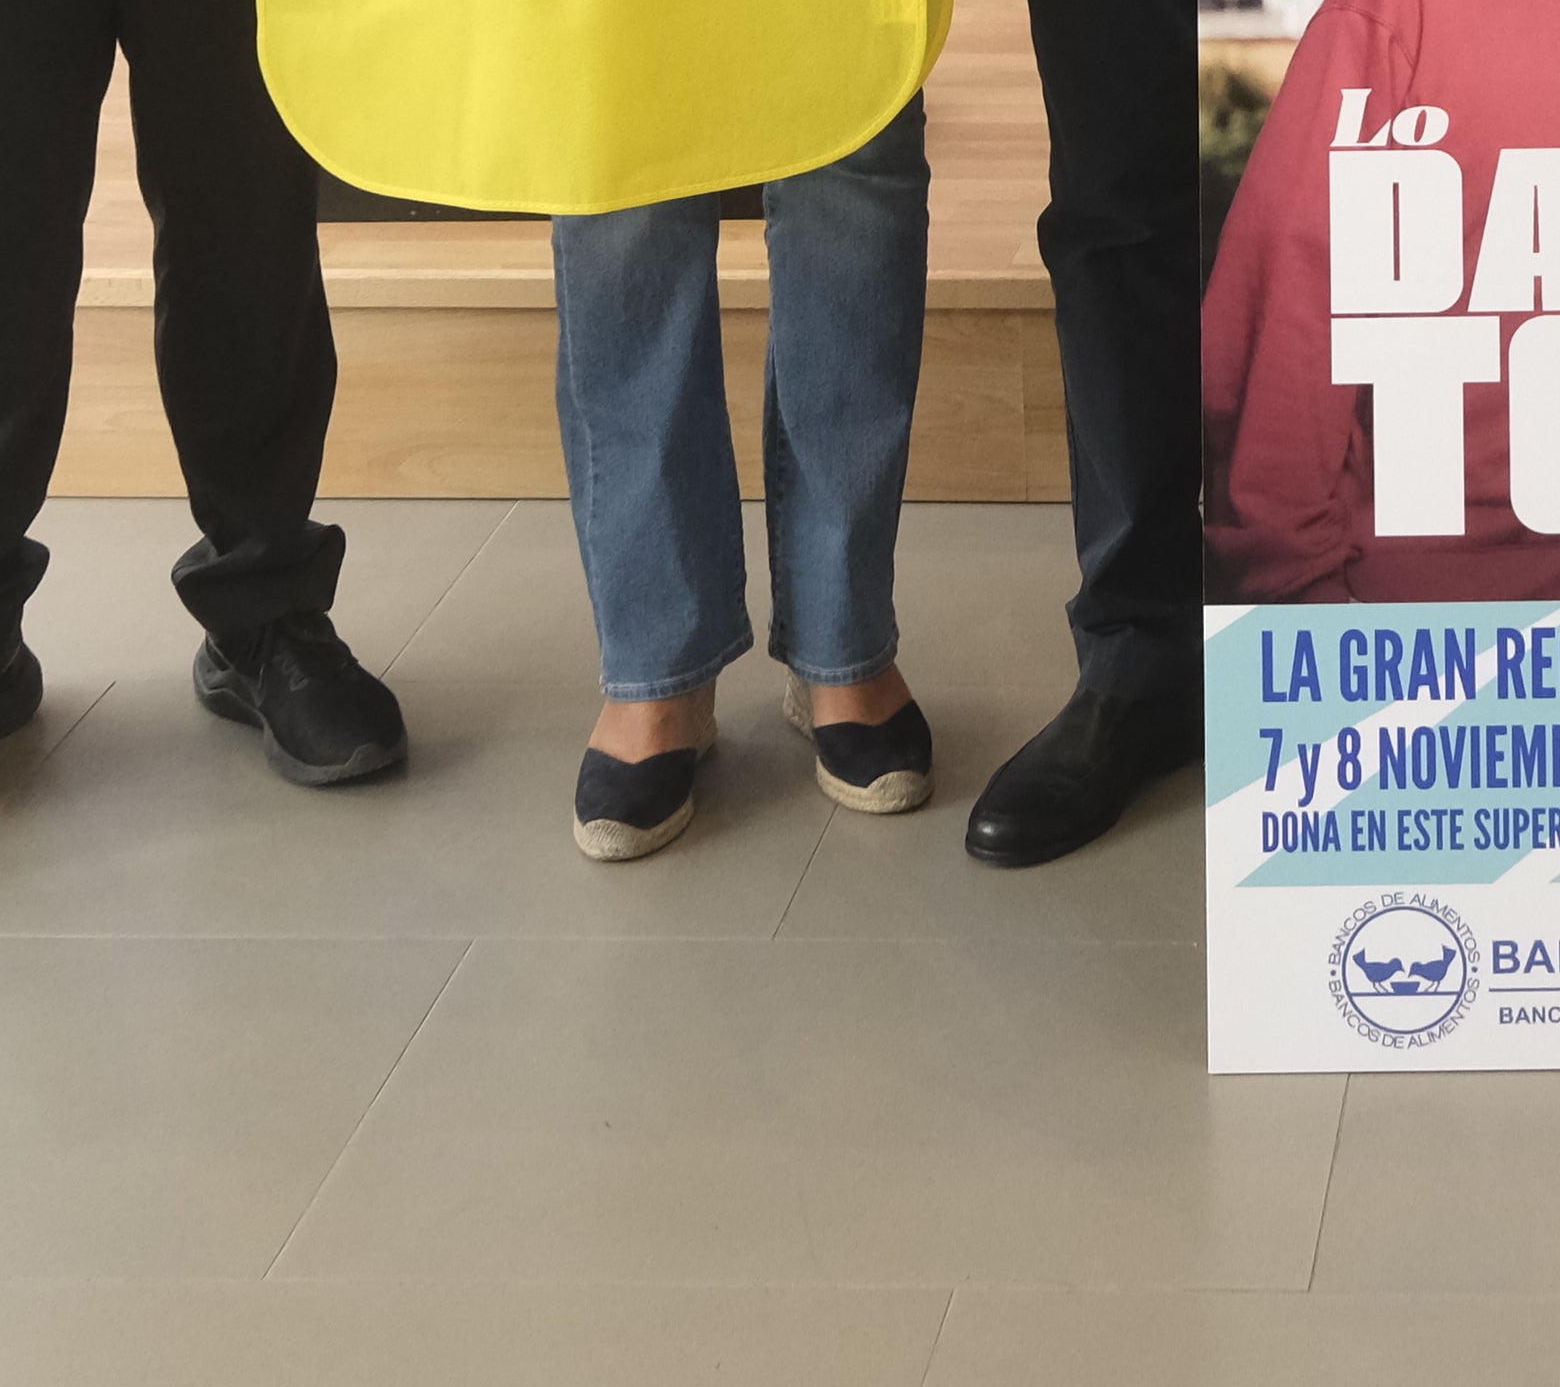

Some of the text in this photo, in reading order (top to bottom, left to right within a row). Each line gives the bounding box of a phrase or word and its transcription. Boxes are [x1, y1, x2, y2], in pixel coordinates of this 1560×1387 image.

[1330, 87, 1450, 148] Lo
[1261, 630, 1323, 703] LA
[1340, 628, 1477, 702] GRAN
[1260, 728, 1284, 792] 7
[1297, 742, 1322, 807] y
[1337, 726, 1363, 791] 8
[1261, 810, 1342, 854] DONA
[1351, 810, 1387, 852] EN
[1397, 808, 1464, 851] ESTE
[1328, 891, 1481, 965] BANCOS DE ALIMENTOS
[1328, 977, 1481, 1050] BANCOS DE ALIMENTOS
